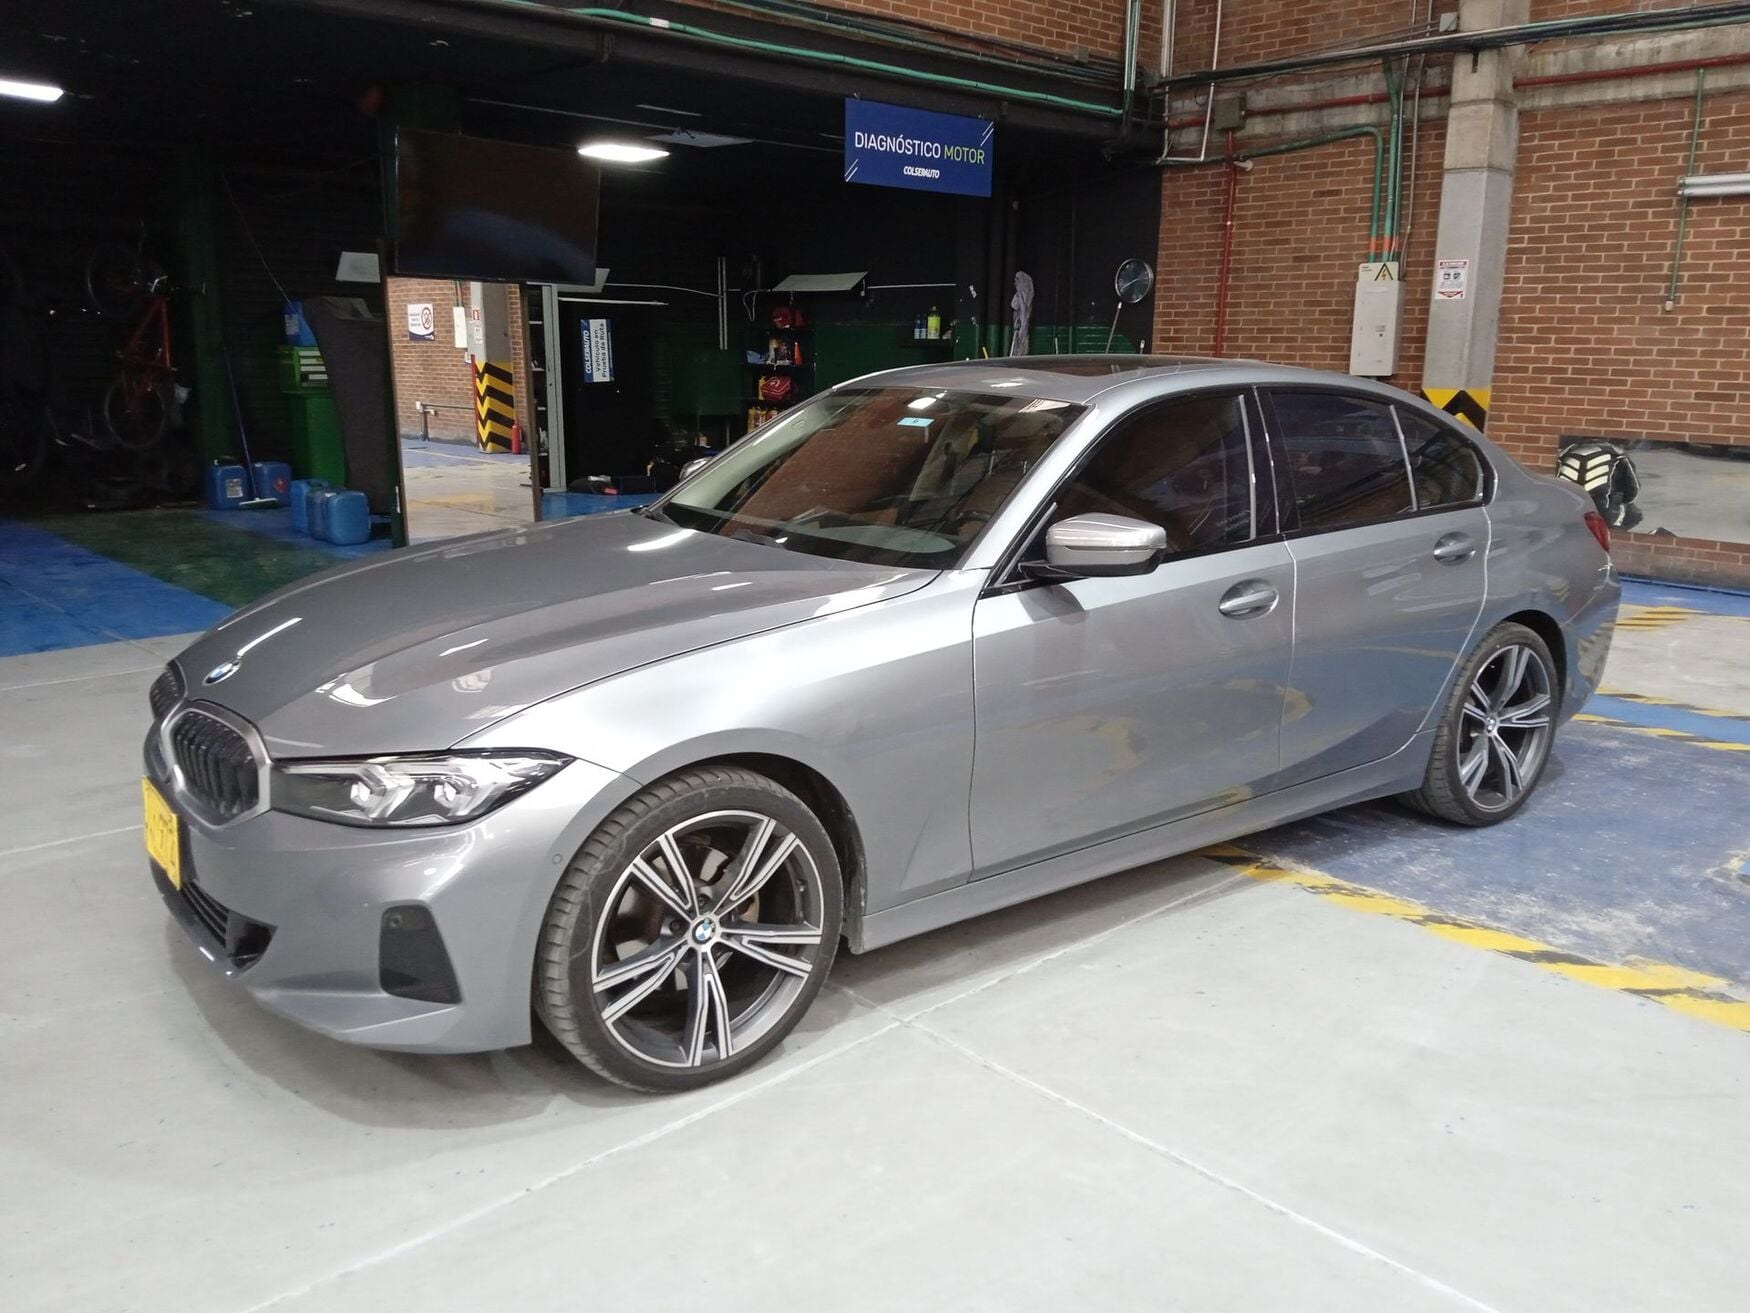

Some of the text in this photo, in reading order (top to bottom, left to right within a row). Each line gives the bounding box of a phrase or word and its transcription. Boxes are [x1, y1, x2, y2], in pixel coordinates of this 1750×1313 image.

[855, 131, 985, 165] DIAGNÓSTICO MOTOR
[903, 165, 940, 179] COLSERAUTO
[583, 330, 592, 374] COLSERAUTO
